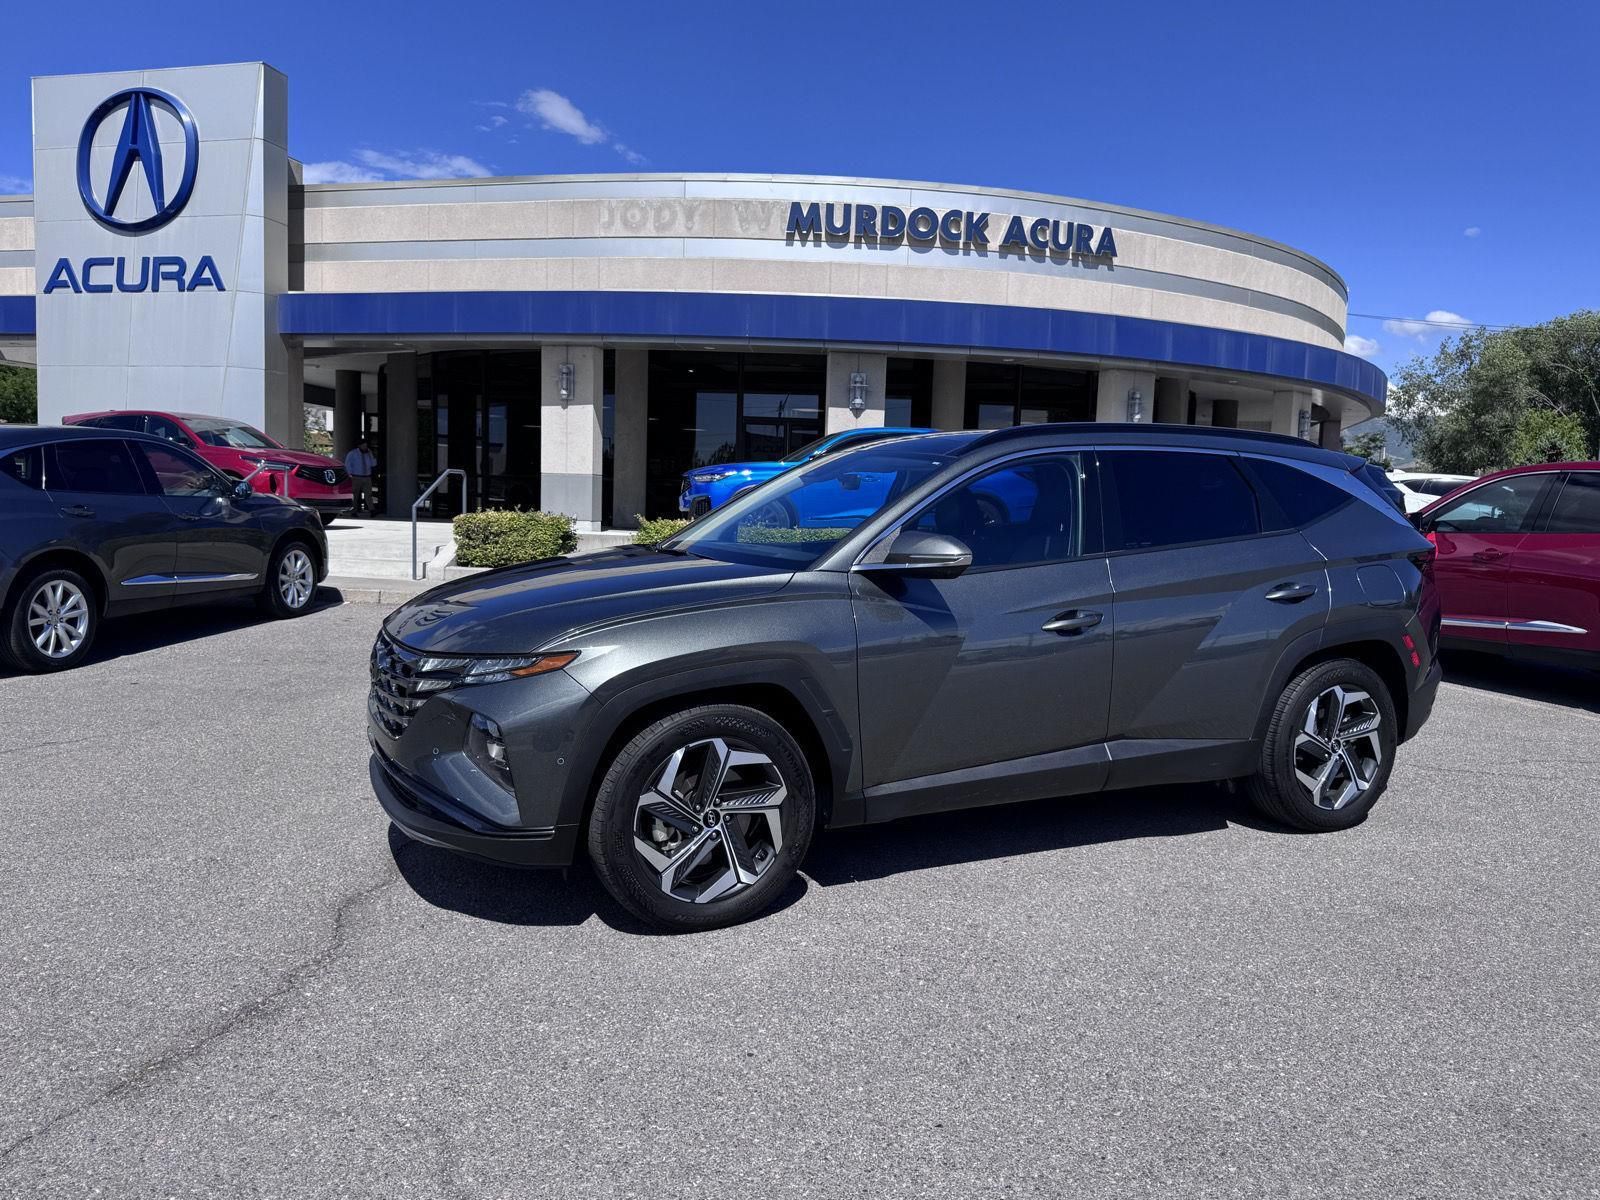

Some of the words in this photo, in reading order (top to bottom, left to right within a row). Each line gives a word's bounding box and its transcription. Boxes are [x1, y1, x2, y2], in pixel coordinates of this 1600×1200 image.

[600, 199, 701, 233] JODY
[733, 199, 786, 233] W
[786, 201, 991, 245] MURDOCK
[1002, 214, 1118, 258] ACURA
[43, 255, 226, 294] ACURA
